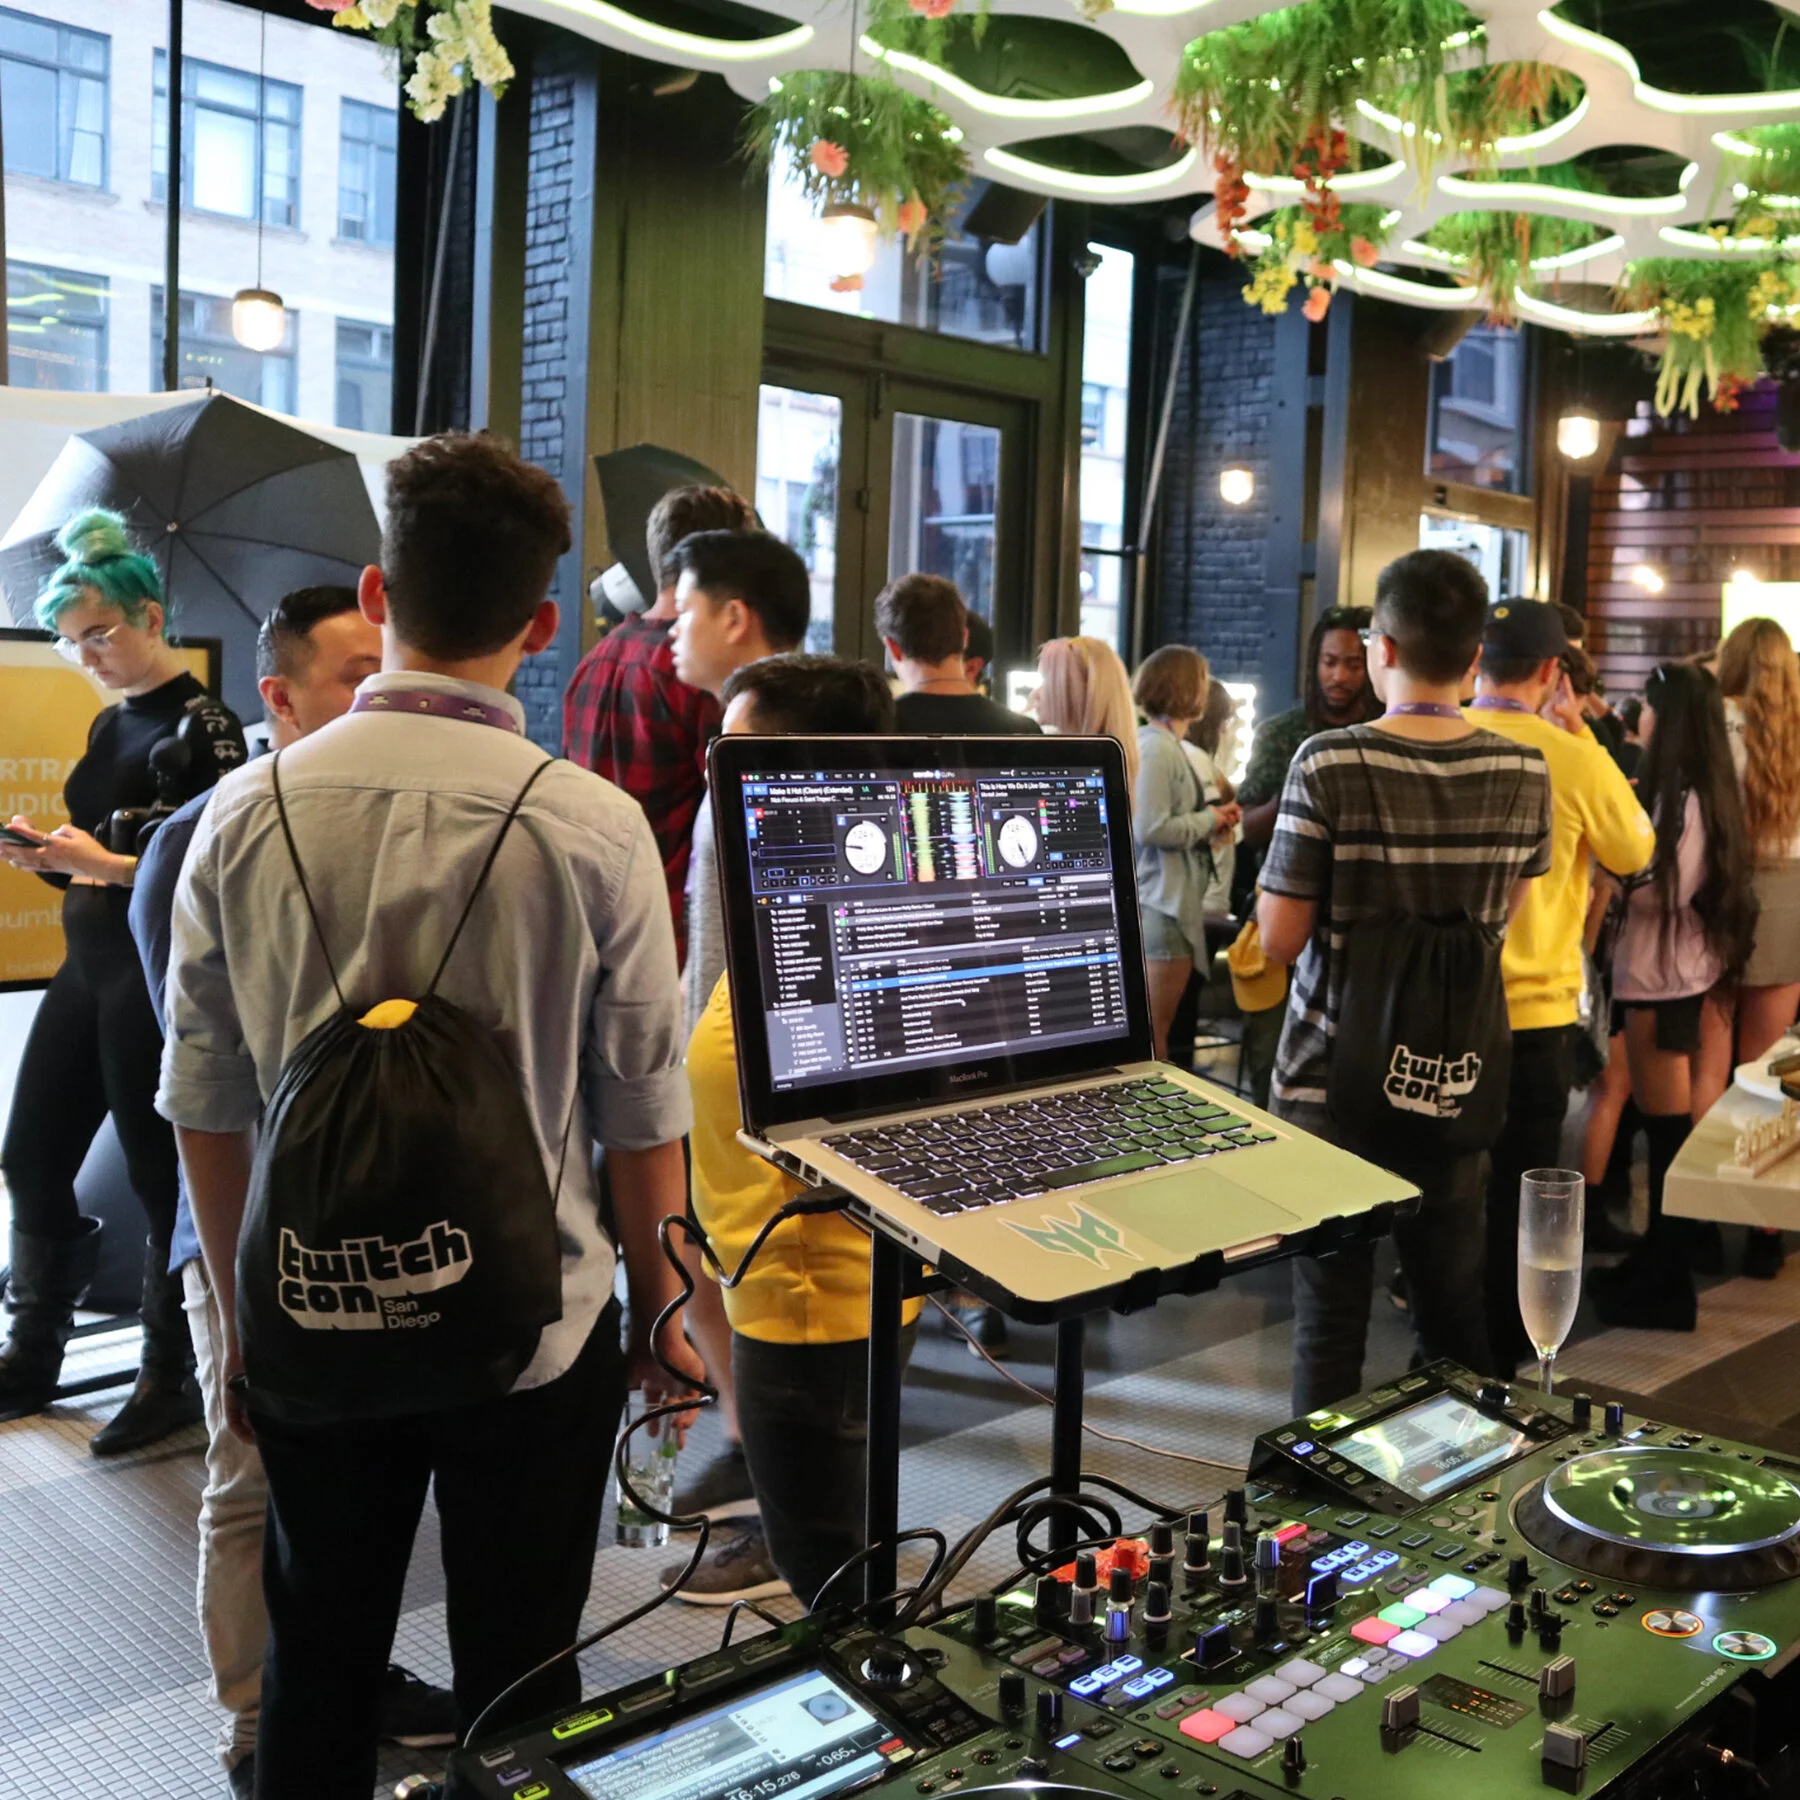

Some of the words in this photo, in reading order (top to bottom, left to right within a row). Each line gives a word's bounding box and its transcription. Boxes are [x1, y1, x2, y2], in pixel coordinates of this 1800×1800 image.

[769, 787, 786, 795] Make
[791, 787, 802, 795] Hot
[949, 1071, 977, 1083] MacBook
[977, 1070, 989, 1079] Pro
[278, 1220, 473, 1298] twitch
[278, 1277, 385, 1330] con
[383, 1300, 419, 1314] San
[386, 1310, 441, 1330] Diego
